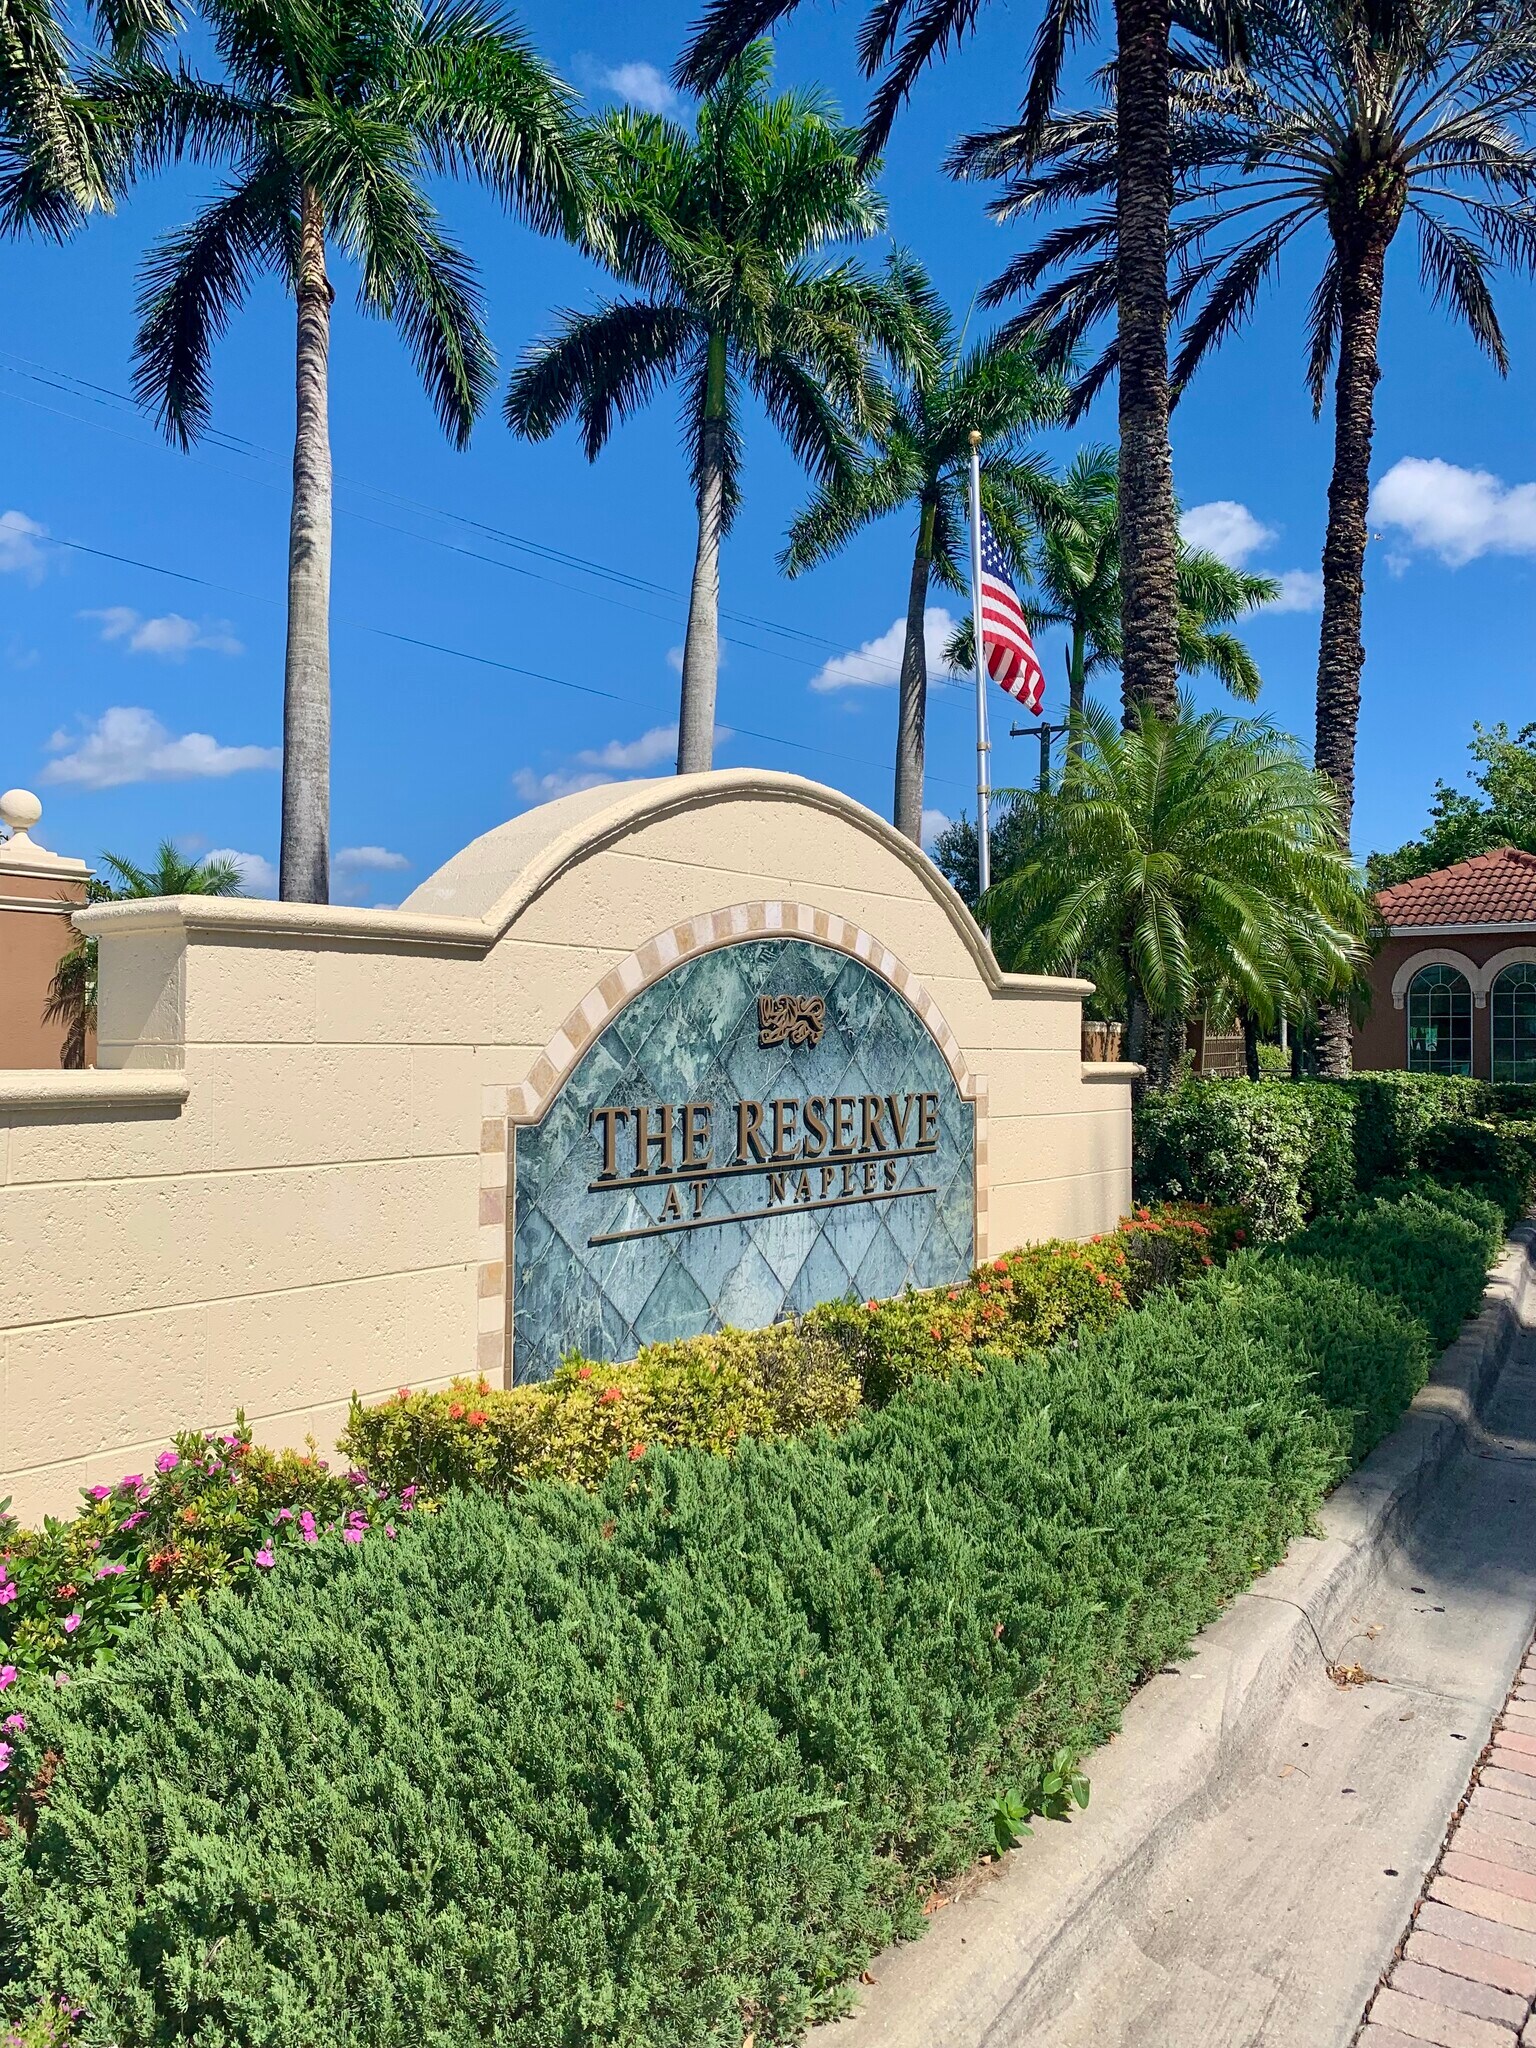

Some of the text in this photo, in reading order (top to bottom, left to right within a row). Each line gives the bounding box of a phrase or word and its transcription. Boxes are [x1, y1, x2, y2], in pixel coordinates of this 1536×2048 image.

[590, 1092, 940, 1180] THE RESERVE
[660, 1162, 897, 1221] AT NAPLES
